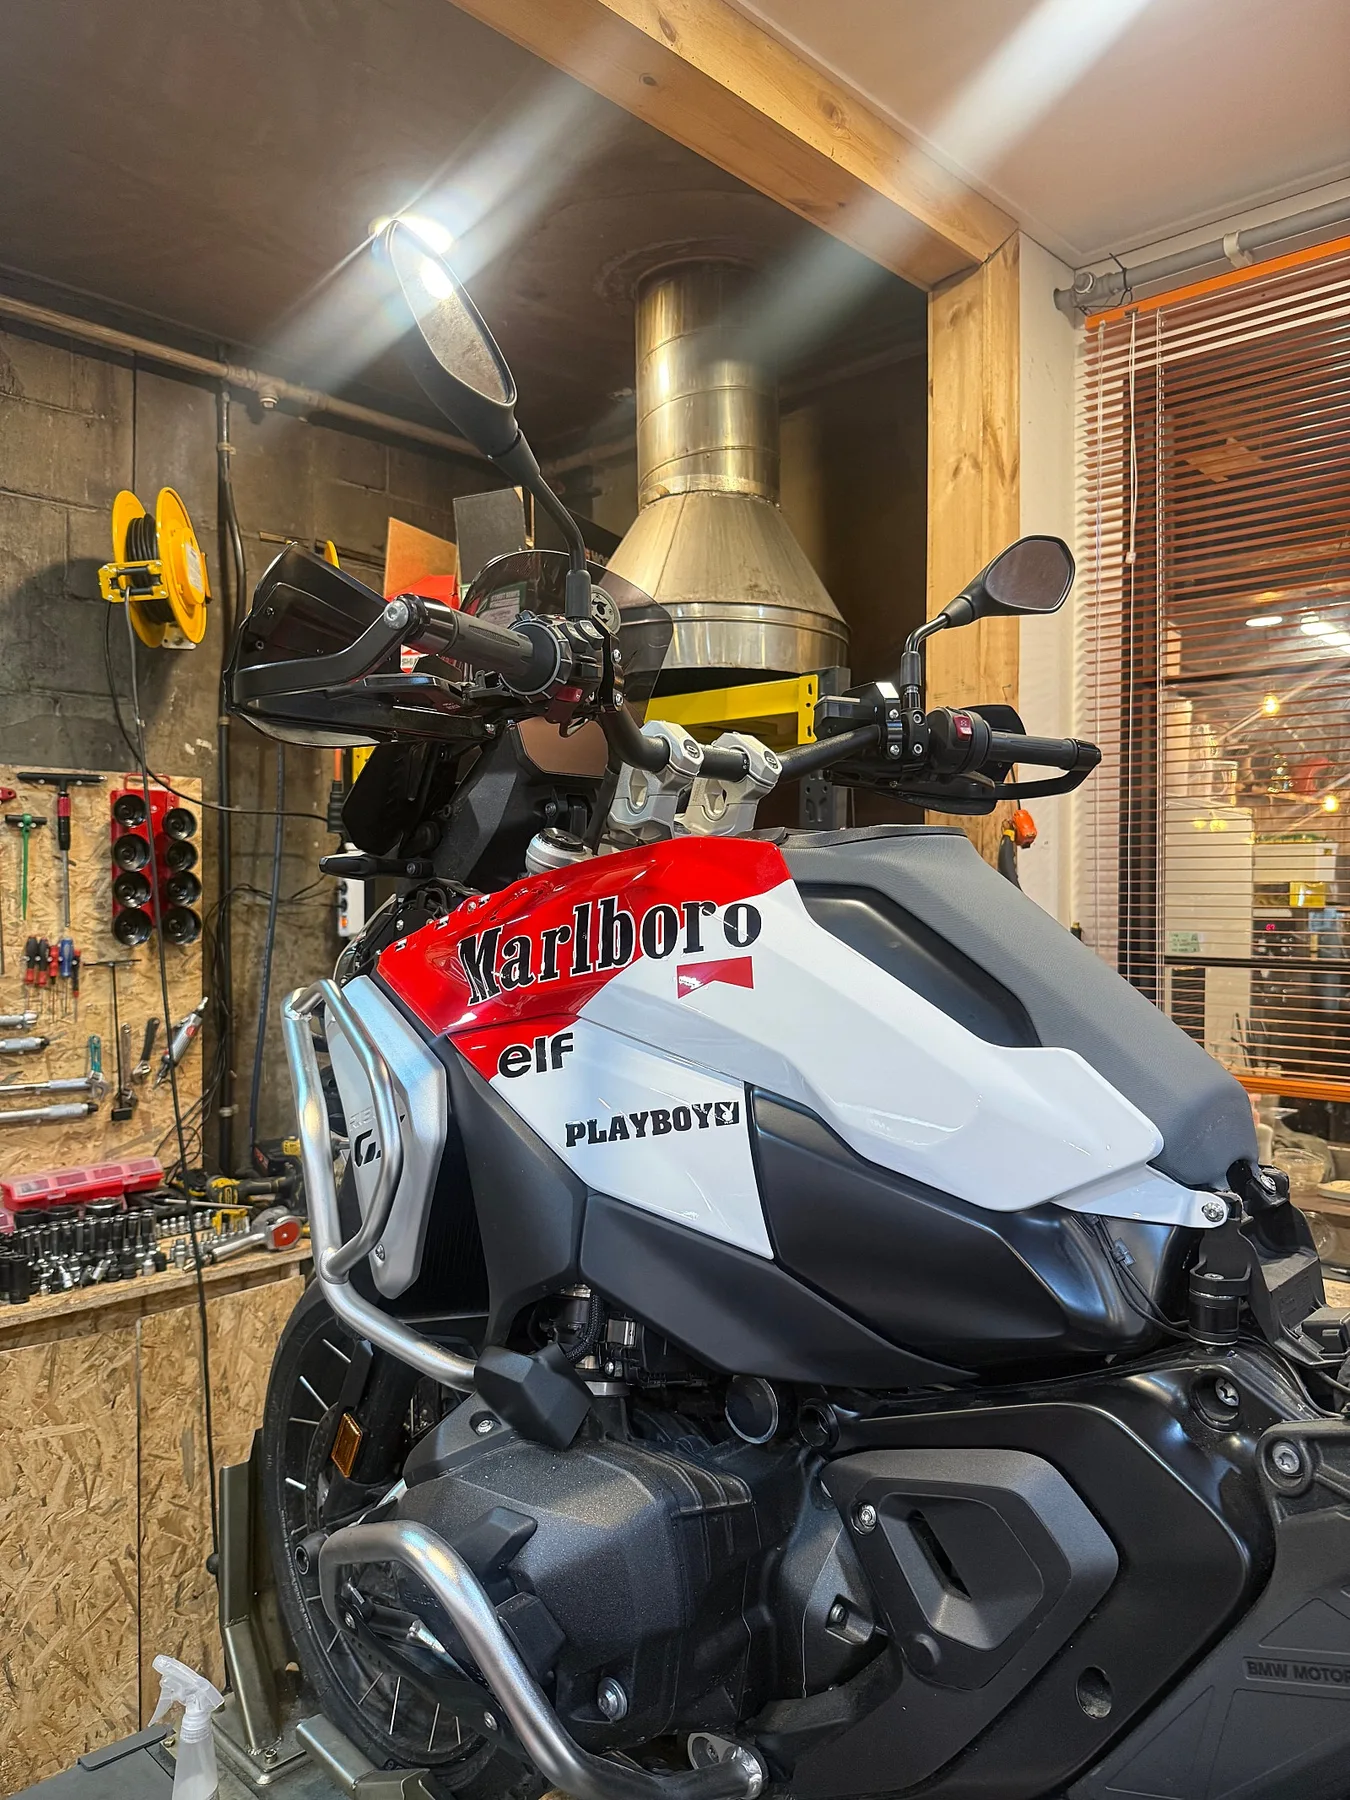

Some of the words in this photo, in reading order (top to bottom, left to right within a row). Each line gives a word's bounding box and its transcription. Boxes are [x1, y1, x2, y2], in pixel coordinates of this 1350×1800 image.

[458, 895, 763, 1006] Marlboro
[498, 1032, 574, 1079] elf
[565, 1103, 712, 1147] PLAYBOY
[1246, 1660, 1288, 1678] BMW
